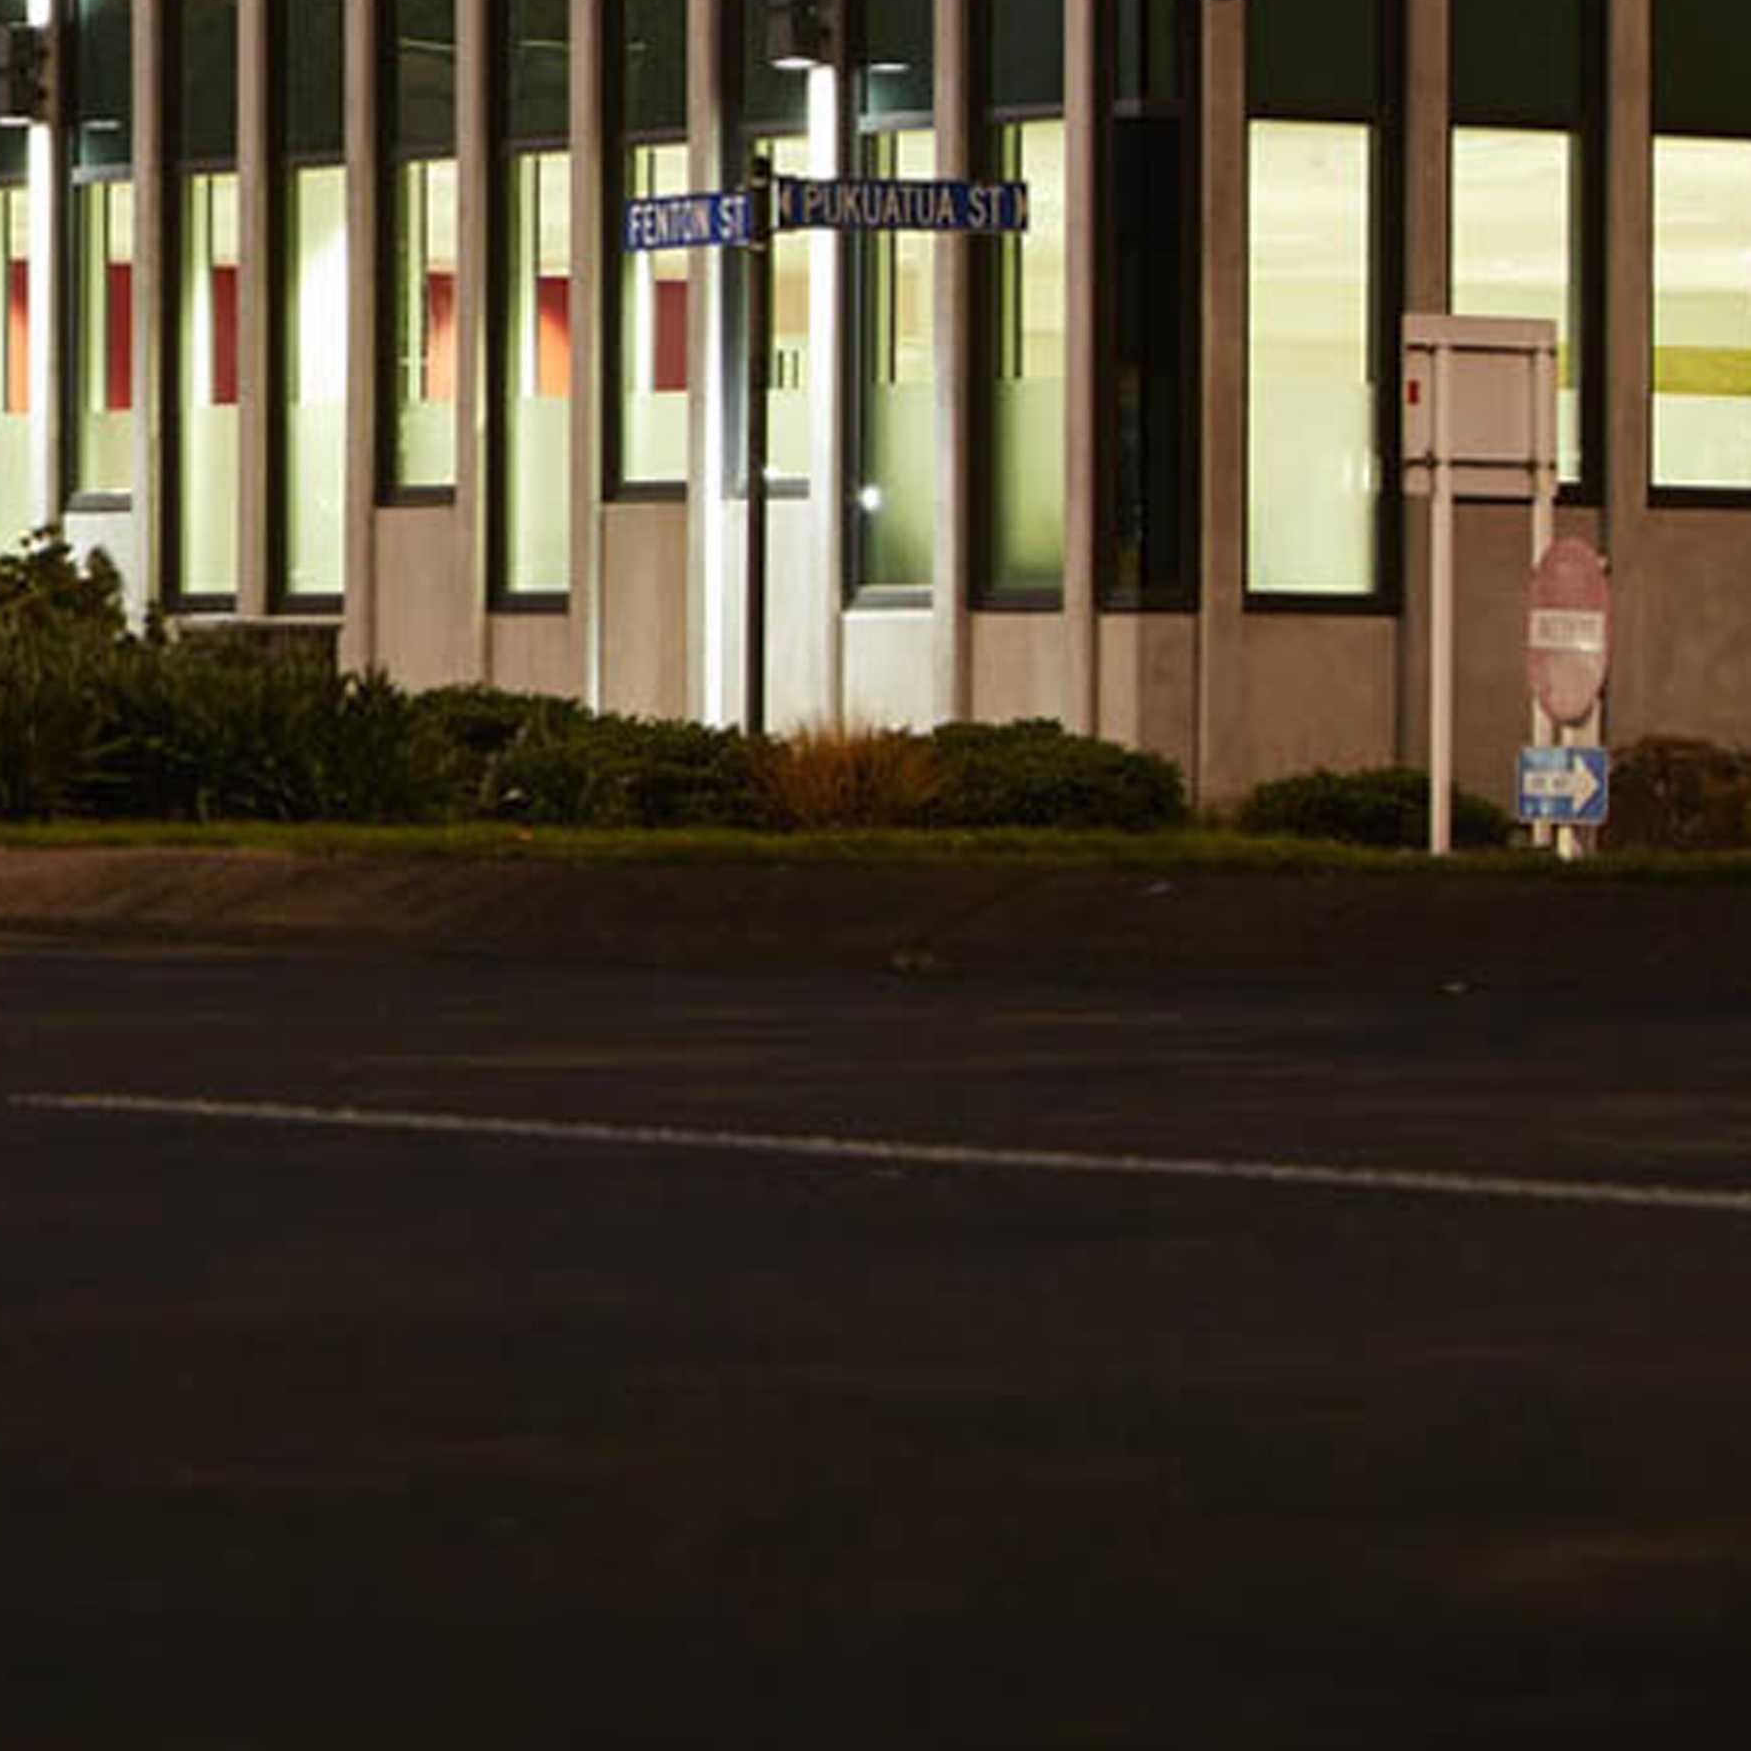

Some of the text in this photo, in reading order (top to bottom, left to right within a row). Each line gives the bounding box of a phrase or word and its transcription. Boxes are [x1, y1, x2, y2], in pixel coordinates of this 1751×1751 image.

[628, 195, 749, 247] FENTON ST
[801, 183, 1005, 228] PUKUATUA ST
